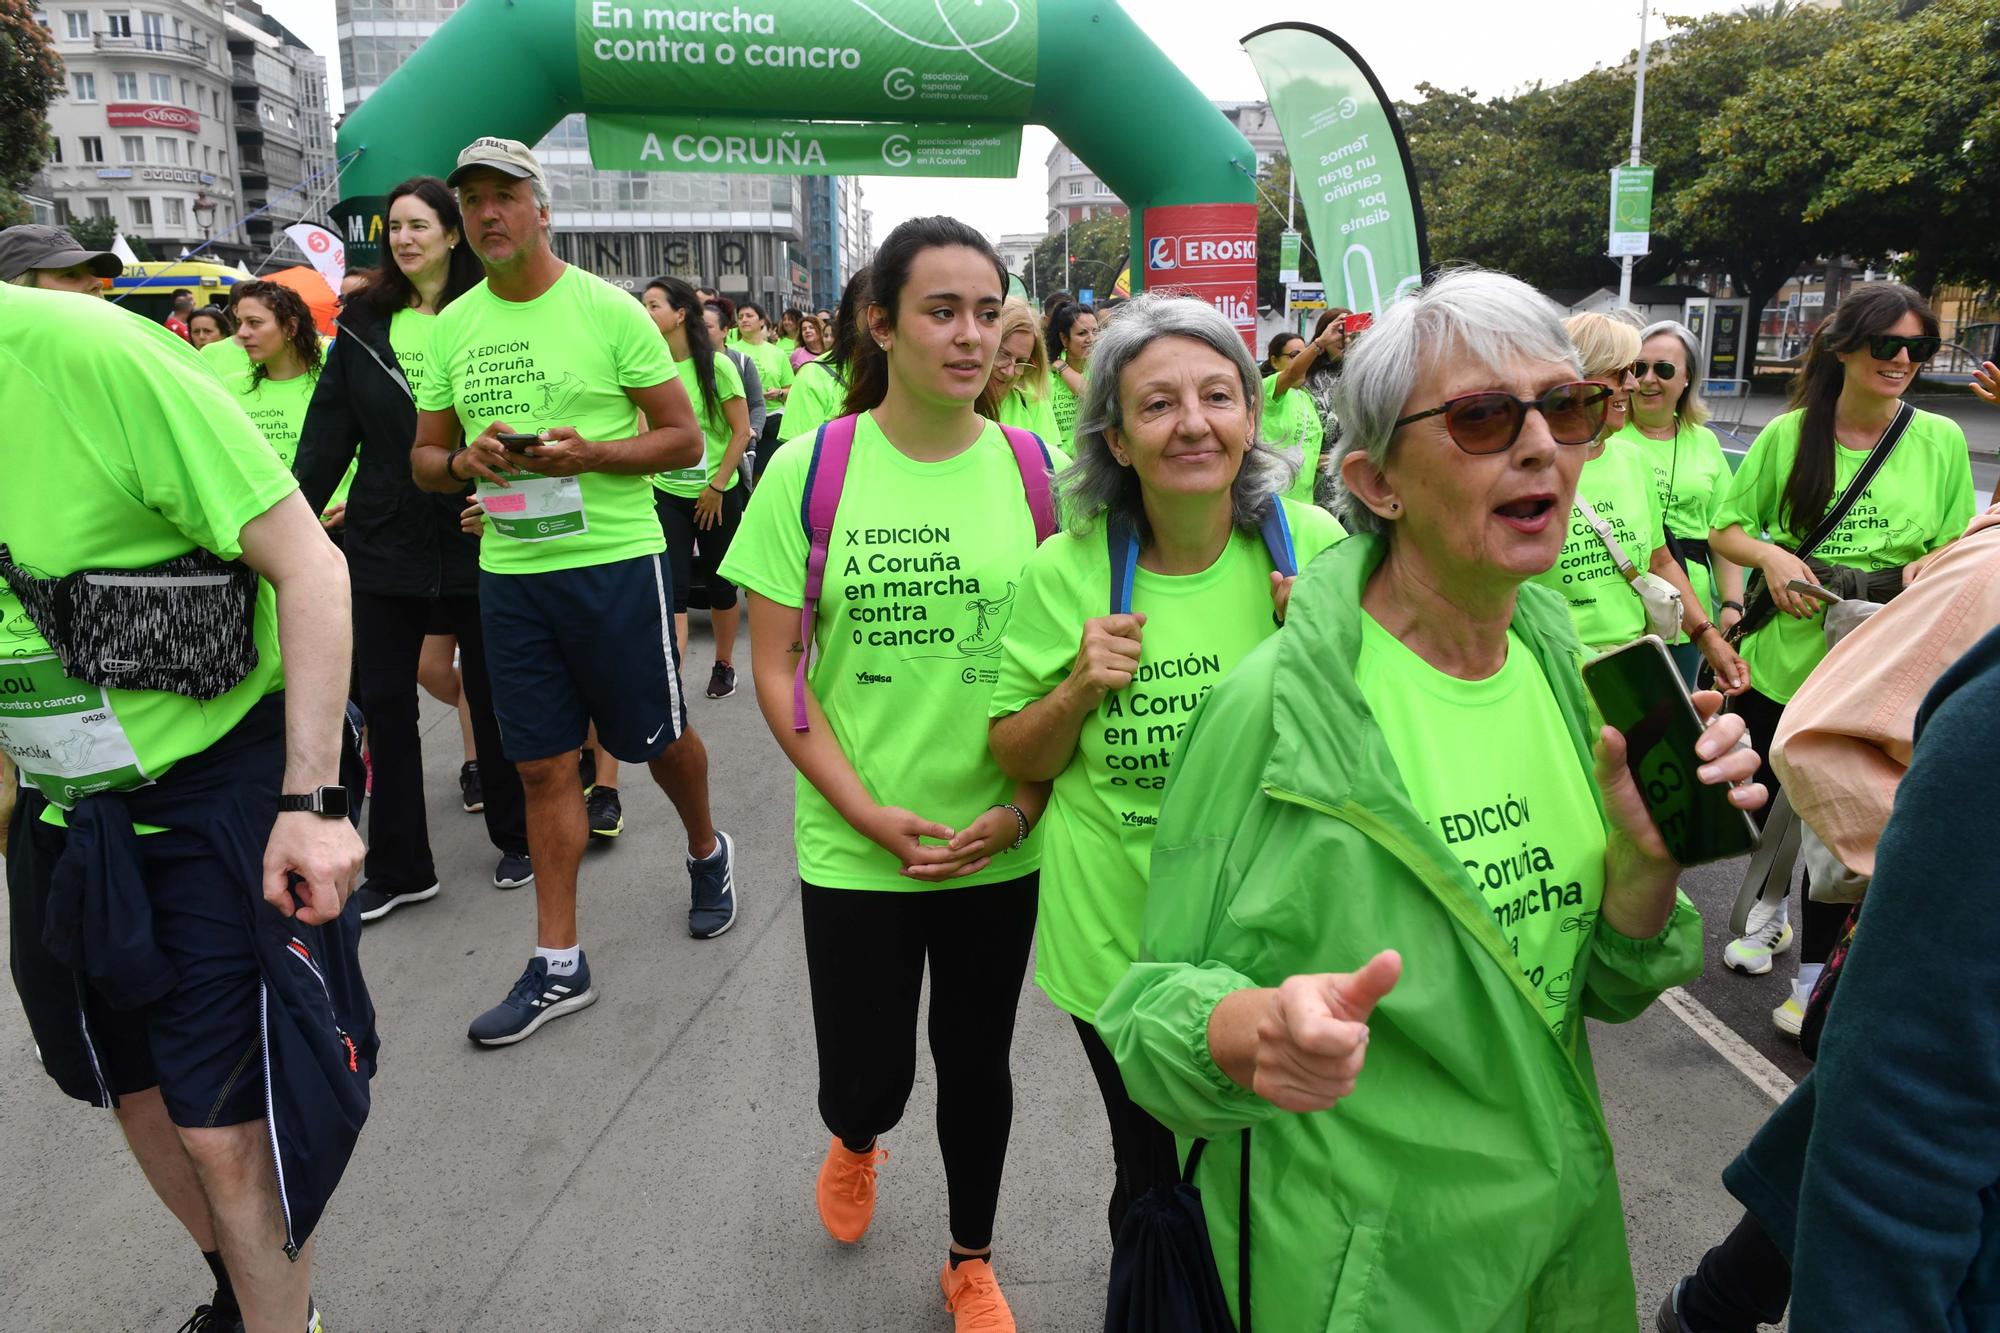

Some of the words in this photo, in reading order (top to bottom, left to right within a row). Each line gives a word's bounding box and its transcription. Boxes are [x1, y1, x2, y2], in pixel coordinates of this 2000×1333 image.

[592, 1, 633, 29] En
[643, 6, 775, 34] marcha
[594, 35, 705, 64] contra
[715, 43, 736, 65] o
[744, 44, 861, 69] cancro
[922, 72, 969, 81] asociación
[921, 83, 961, 91] española
[148, 111, 189, 122] SVENSON
[640, 133, 666, 161] A
[673, 131, 827, 166] CORUÑA
[963, 138, 1001, 147] española
[936, 157, 967, 165] Coruña
[596, 241, 747, 270] NGO
[1186, 240, 1256, 261] EROSKI
[1215, 295, 1249, 320] ilia
[394, 351, 424, 361] DICIÓ
[467, 349, 475, 360] X
[478, 340, 529, 357] EDICIÓN
[466, 364, 474, 376] A
[479, 357, 534, 373] Coruña
[464, 379, 480, 390] en
[485, 370, 545, 386] marcha
[463, 389, 512, 404] contra
[468, 409, 475, 418] o
[478, 403, 530, 417] cancro
[255, 421, 288, 429] oruña
[264, 430, 297, 439] archa
[846, 530, 859, 546] X
[865, 524, 950, 545] EDICIÓN
[1573, 517, 1625, 536] Coña
[1585, 530, 1636, 550] maha
[843, 556, 861, 576] A
[868, 552, 961, 573] Coruña
[1560, 552, 1610, 569] contra
[1562, 574, 1572, 584] o
[1577, 564, 1619, 581] cancr
[844, 582, 876, 600] en
[884, 575, 980, 597] marcha
[849, 602, 927, 623] contra
[853, 630, 862, 645] o
[868, 626, 955, 647] cancro
[855, 672, 892, 684] Vegalsa
[34, 701, 41, 709] o
[44, 694, 86, 708] cancro
[1107, 695, 1123, 718] A
[1130, 685, 1213, 716] Coru
[81, 713, 106, 724] 0426
[1104, 727, 1138, 745] en
[1105, 748, 1174, 771] cont
[1110, 776, 1127, 786] o
[1121, 811, 1158, 826] Vegals
[1440, 793, 1530, 844] EDICIÓN
[552, 960, 573, 968] FILA
